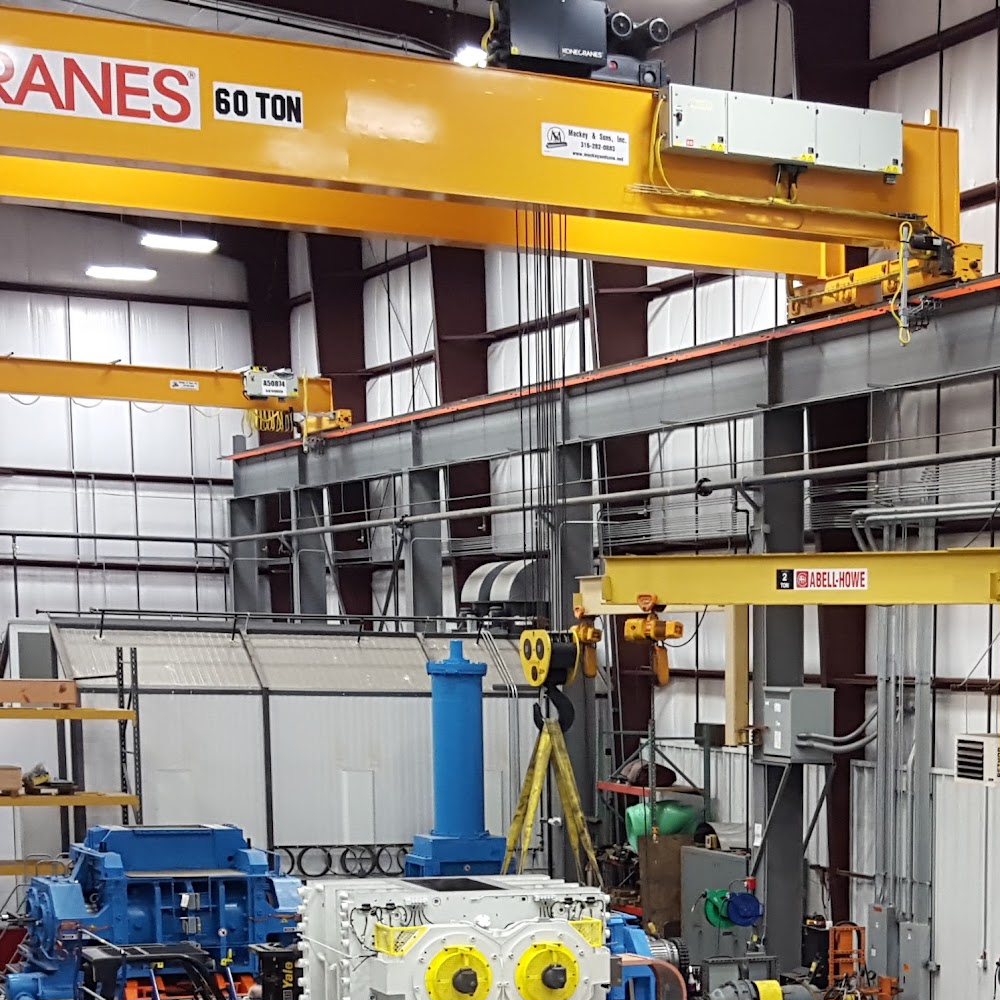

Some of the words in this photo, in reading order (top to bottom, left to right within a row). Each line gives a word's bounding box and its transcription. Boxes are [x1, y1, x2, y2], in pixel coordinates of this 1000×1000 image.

[562, 47, 603, 59] KONECRANES
[215, 88, 249, 117] 60
[255, 92, 302, 123] TON
[568, 129, 588, 140] Mackey
[592, 132, 596, 140] &
[617, 135, 627, 144] Inc.
[782, 572, 788, 582] 2
[810, 571, 866, 588] ABELL-HOWE
[282, 961, 294, 989] Yale
